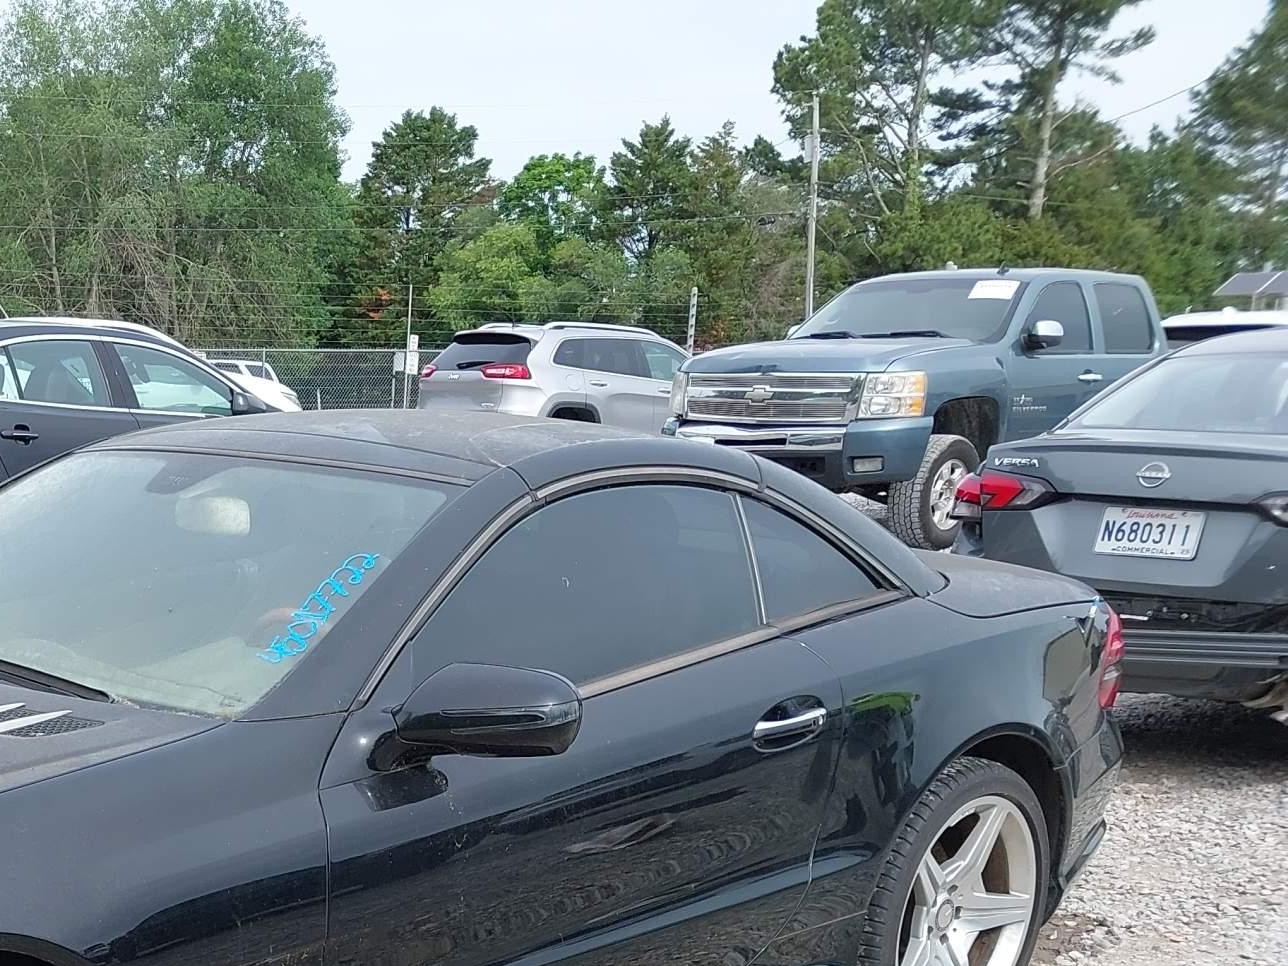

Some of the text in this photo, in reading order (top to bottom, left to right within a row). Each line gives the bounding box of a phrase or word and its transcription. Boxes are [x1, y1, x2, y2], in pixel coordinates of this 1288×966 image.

[994, 457, 1039, 468] VERSA
[1101, 519, 1191, 547] N680311
[1116, 545, 1169, 555] COMMERCIAL
